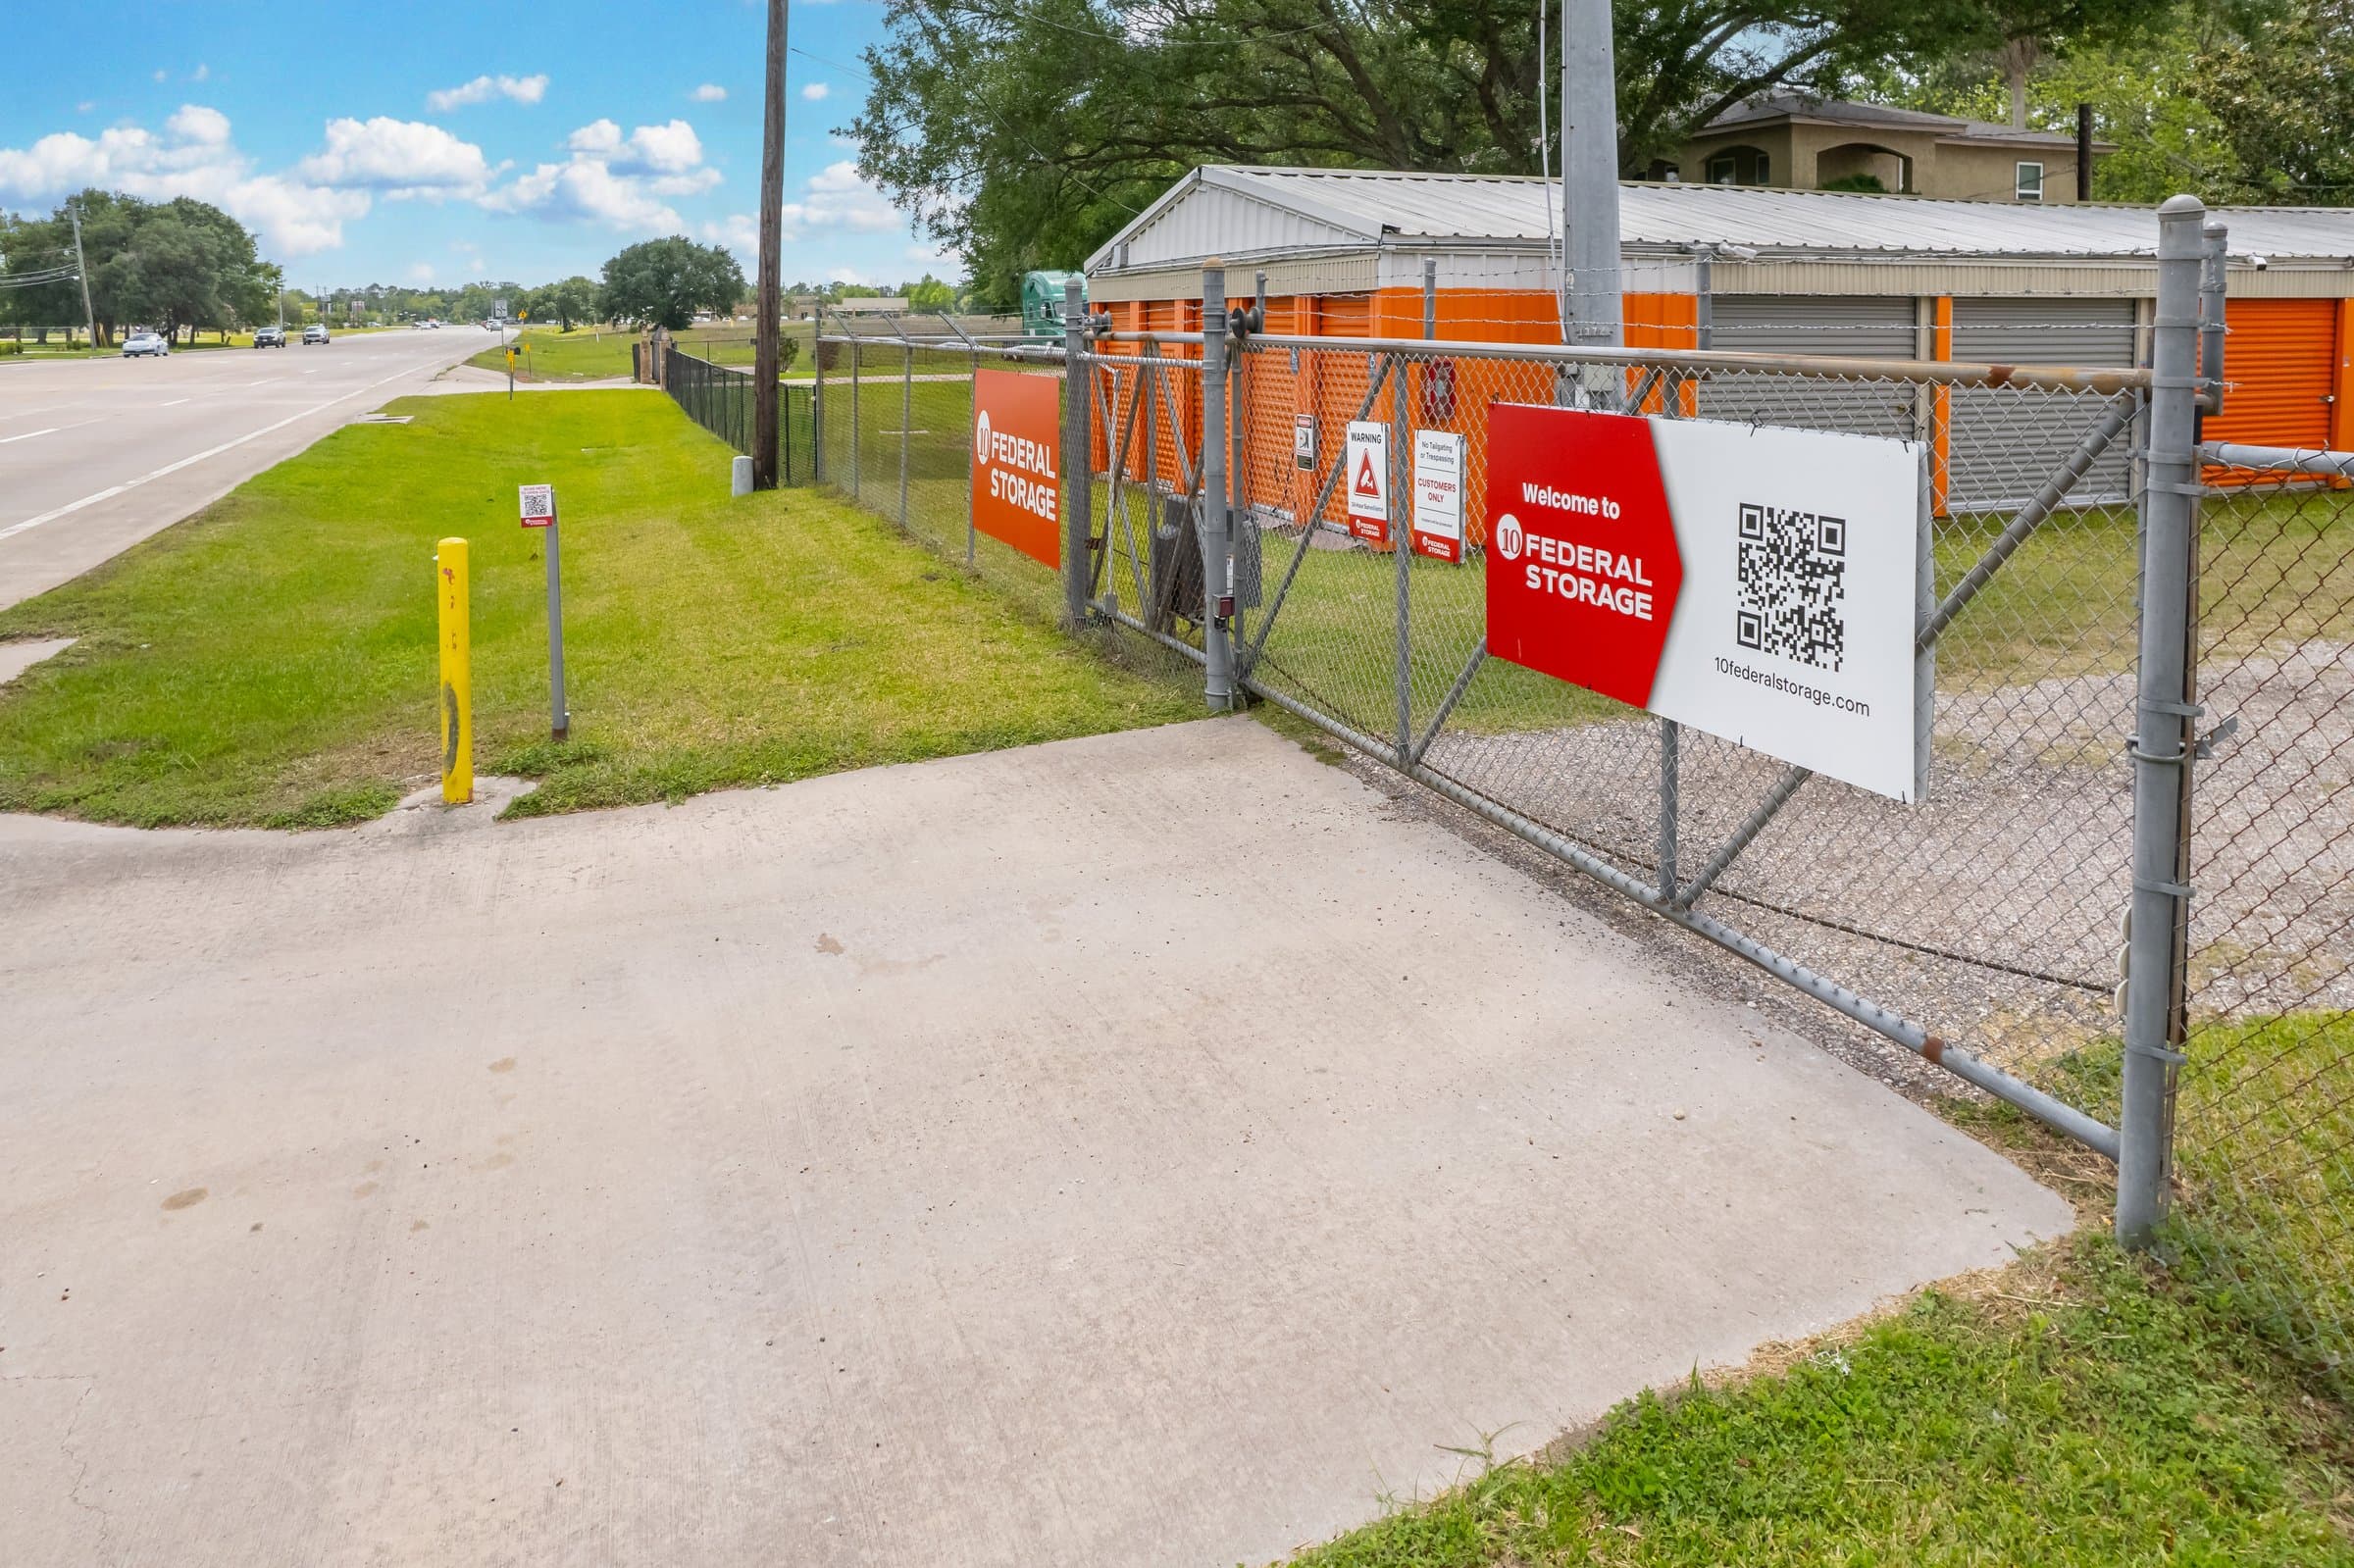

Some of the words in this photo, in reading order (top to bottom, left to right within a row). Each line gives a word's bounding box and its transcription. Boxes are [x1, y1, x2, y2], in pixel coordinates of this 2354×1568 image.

[1351, 431, 1382, 444] WARNING
[992, 431, 1056, 480] FEDERAL
[1426, 452, 1455, 465] Trespassing
[991, 468, 1056, 522] STORAGE
[1417, 478, 1457, 493] CUSTOMERS
[1428, 492, 1444, 503] ONLY
[1522, 481, 1599, 516] Welcome
[1602, 496, 1620, 520] to
[1428, 539, 1451, 551] FEDERAL
[1428, 546, 1451, 557] STORAGE
[1501, 528, 1521, 555] 10
[1525, 532, 1653, 587] FEDERAL
[1525, 564, 1653, 621] STORAGE
[1714, 656, 1870, 717] 10federalstorage.com
